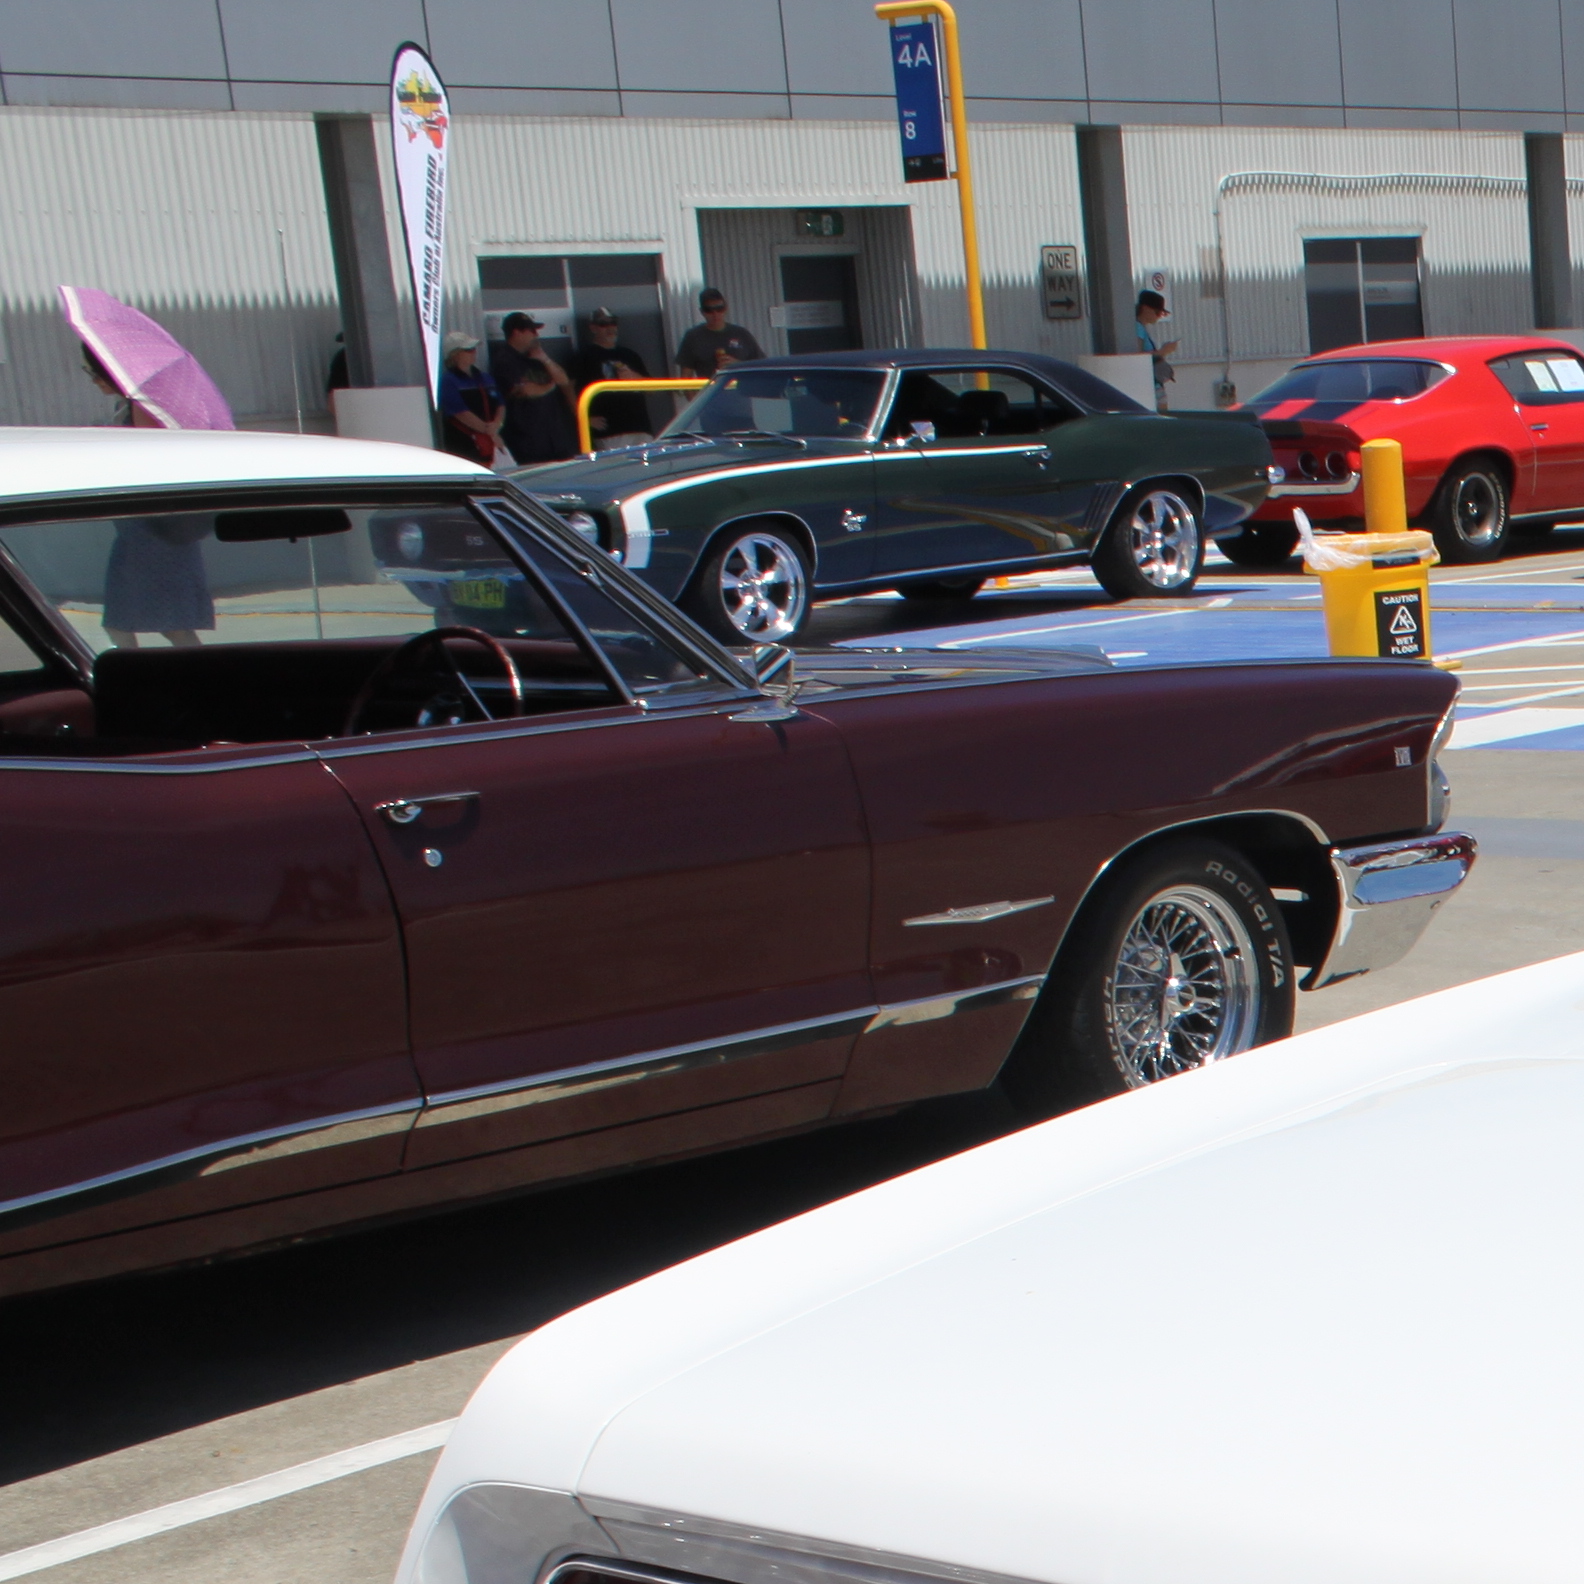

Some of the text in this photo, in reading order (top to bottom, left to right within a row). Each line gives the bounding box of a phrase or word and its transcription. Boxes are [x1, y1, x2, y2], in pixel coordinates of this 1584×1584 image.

[898, 42, 932, 68] 4A
[905, 121, 917, 140] 8
[422, 153, 438, 327] CAMARO FIREBIRD
[1047, 253, 1072, 269] ONE
[1047, 275, 1075, 291] WAY
[1382, 593, 1419, 605] CAUTION
[1395, 635, 1415, 646] WET
[1391, 644, 1420, 655] FLOOR
[1205, 860, 1285, 988] Radial T/A
